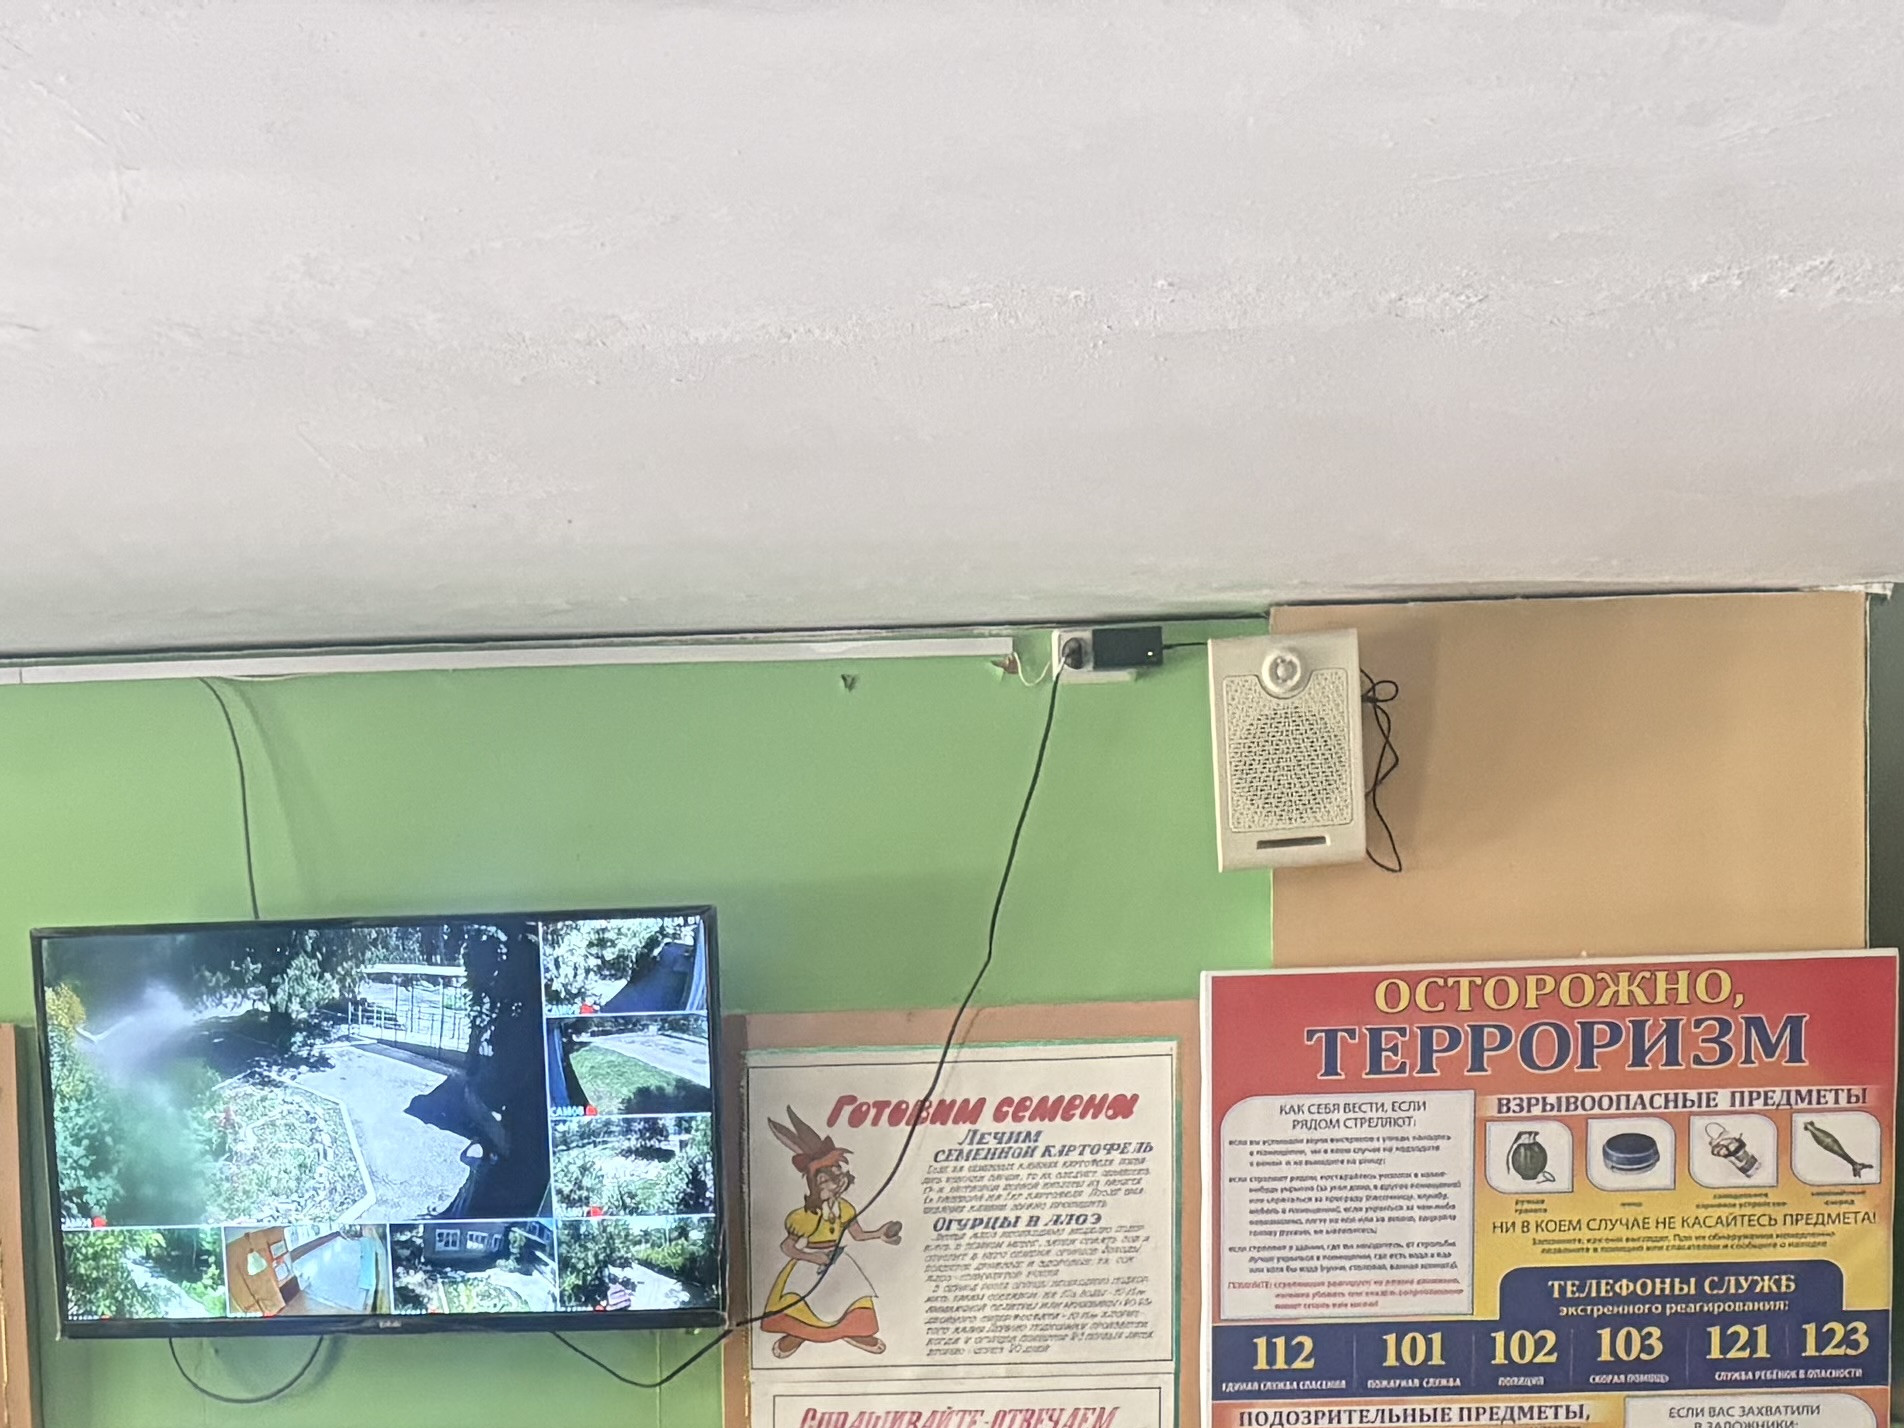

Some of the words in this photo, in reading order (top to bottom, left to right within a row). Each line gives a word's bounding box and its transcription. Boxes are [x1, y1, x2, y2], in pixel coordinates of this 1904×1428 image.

[1374, 968, 1745, 1014] ОСТОРОЖНО,
[1304, 1013, 1809, 1080] ТЕРРОРИЗМ
[826, 1095, 987, 1128] Готовим
[1280, 1103, 1304, 1116] КАК
[1307, 1103, 1340, 1115] СЕБЯ
[1344, 1102, 1388, 1115] ВЕСТИ,
[1391, 1100, 1427, 1113] ЕСЛИ
[1497, 1090, 1719, 1116] ВЗРЫВООПАСНЫЕ
[1729, 1087, 1868, 1108] ПРЕДМЕТЫ
[1292, 1118, 1341, 1131] РЯДОМ
[1042, 1142, 1153, 1158] КАРТОФЕЛЬ
[933, 1215, 1019, 1232] ОГУРЦЫ
[1492, 1221, 1516, 1234] НИ
[1521, 1220, 1531, 1234] В
[1535, 1219, 1582, 1233] КОЕМ
[1586, 1217, 1651, 1232] СЛУЧАЕ
[1655, 1216, 1676, 1230] НЕ
[1681, 1212, 1778, 1229] КАСАЙТЕСЬ
[1783, 1211, 1877, 1228] ПРЕДМЕТА!
[1548, 1277, 1696, 1299] ТЕЛЕФОНЫ
[1703, 1273, 1797, 1294] СЛУЖБ
[1559, 1302, 1662, 1318] экстренного
[1666, 1300, 1789, 1315] реагирования:
[1253, 1335, 1315, 1370] 112
[1382, 1331, 1446, 1367] 101
[1490, 1329, 1558, 1365] 102
[1596, 1326, 1664, 1362] 103
[1706, 1324, 1771, 1360] 121
[1802, 1321, 1870, 1356] 123
[1239, 1407, 1452, 1428] ПОДОЗРИТЕЛЬНЫЕ
[1459, 1403, 1590, 1424] ПРЕДМЕТЫ,
[1668, 1406, 1705, 1418] ЕСЛИ
[1709, 1406, 1734, 1418] ВАС
[1737, 1405, 1821, 1417] ЗАХВАТИЛИ
